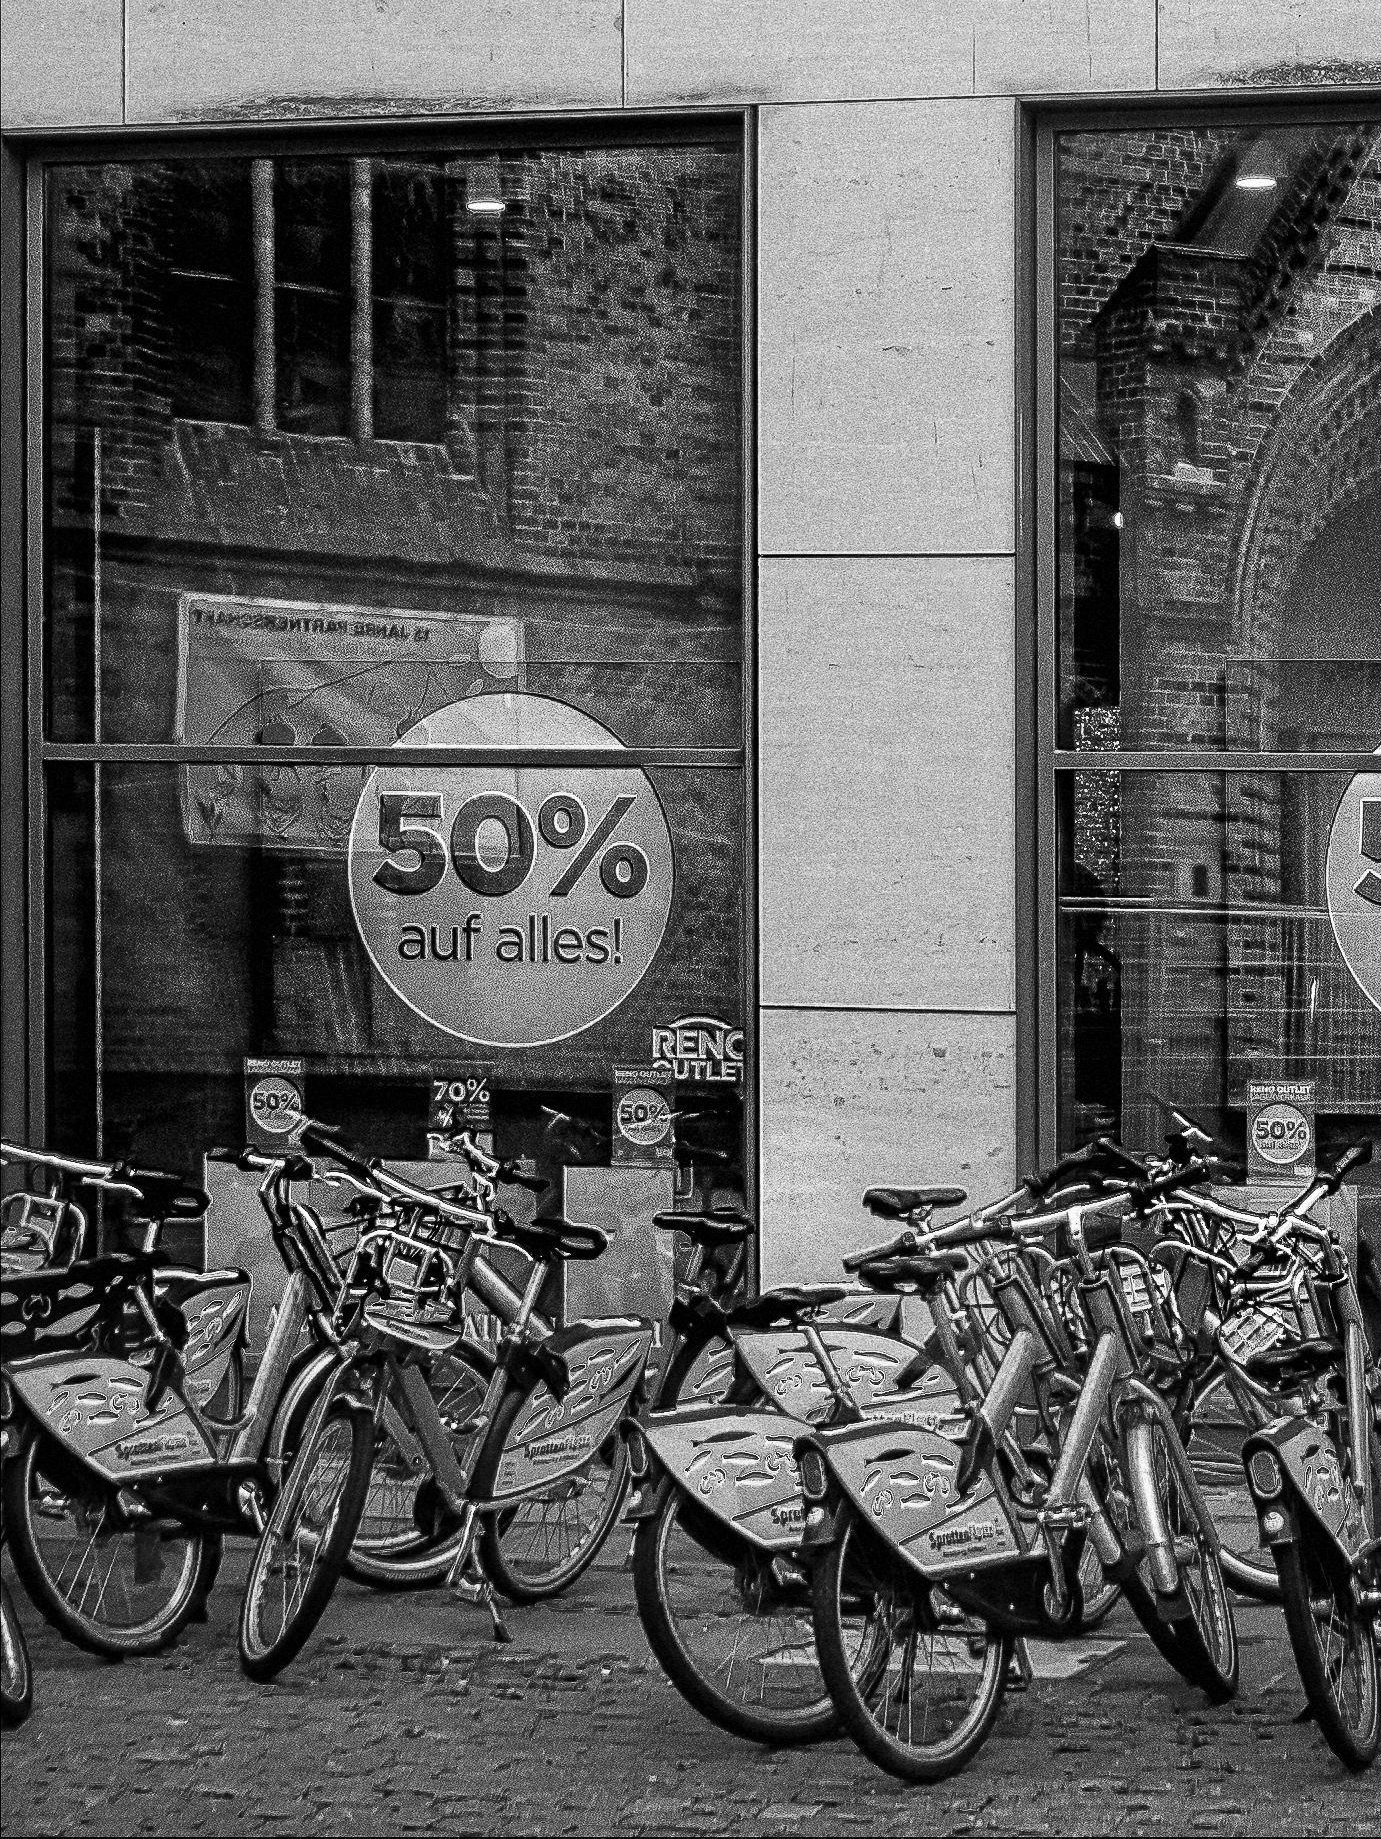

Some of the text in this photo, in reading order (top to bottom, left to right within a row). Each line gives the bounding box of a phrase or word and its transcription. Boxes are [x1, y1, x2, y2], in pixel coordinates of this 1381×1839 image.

[372, 793, 650, 898] 50%
[398, 913, 624, 965] auf alles!
[433, 1077, 491, 1102] 70%
[1277, 1085, 1311, 1094] OUTLET
[254, 1092, 300, 1110] 50%
[620, 1103, 668, 1124] 50%
[1255, 1120, 1307, 1140] 50%
